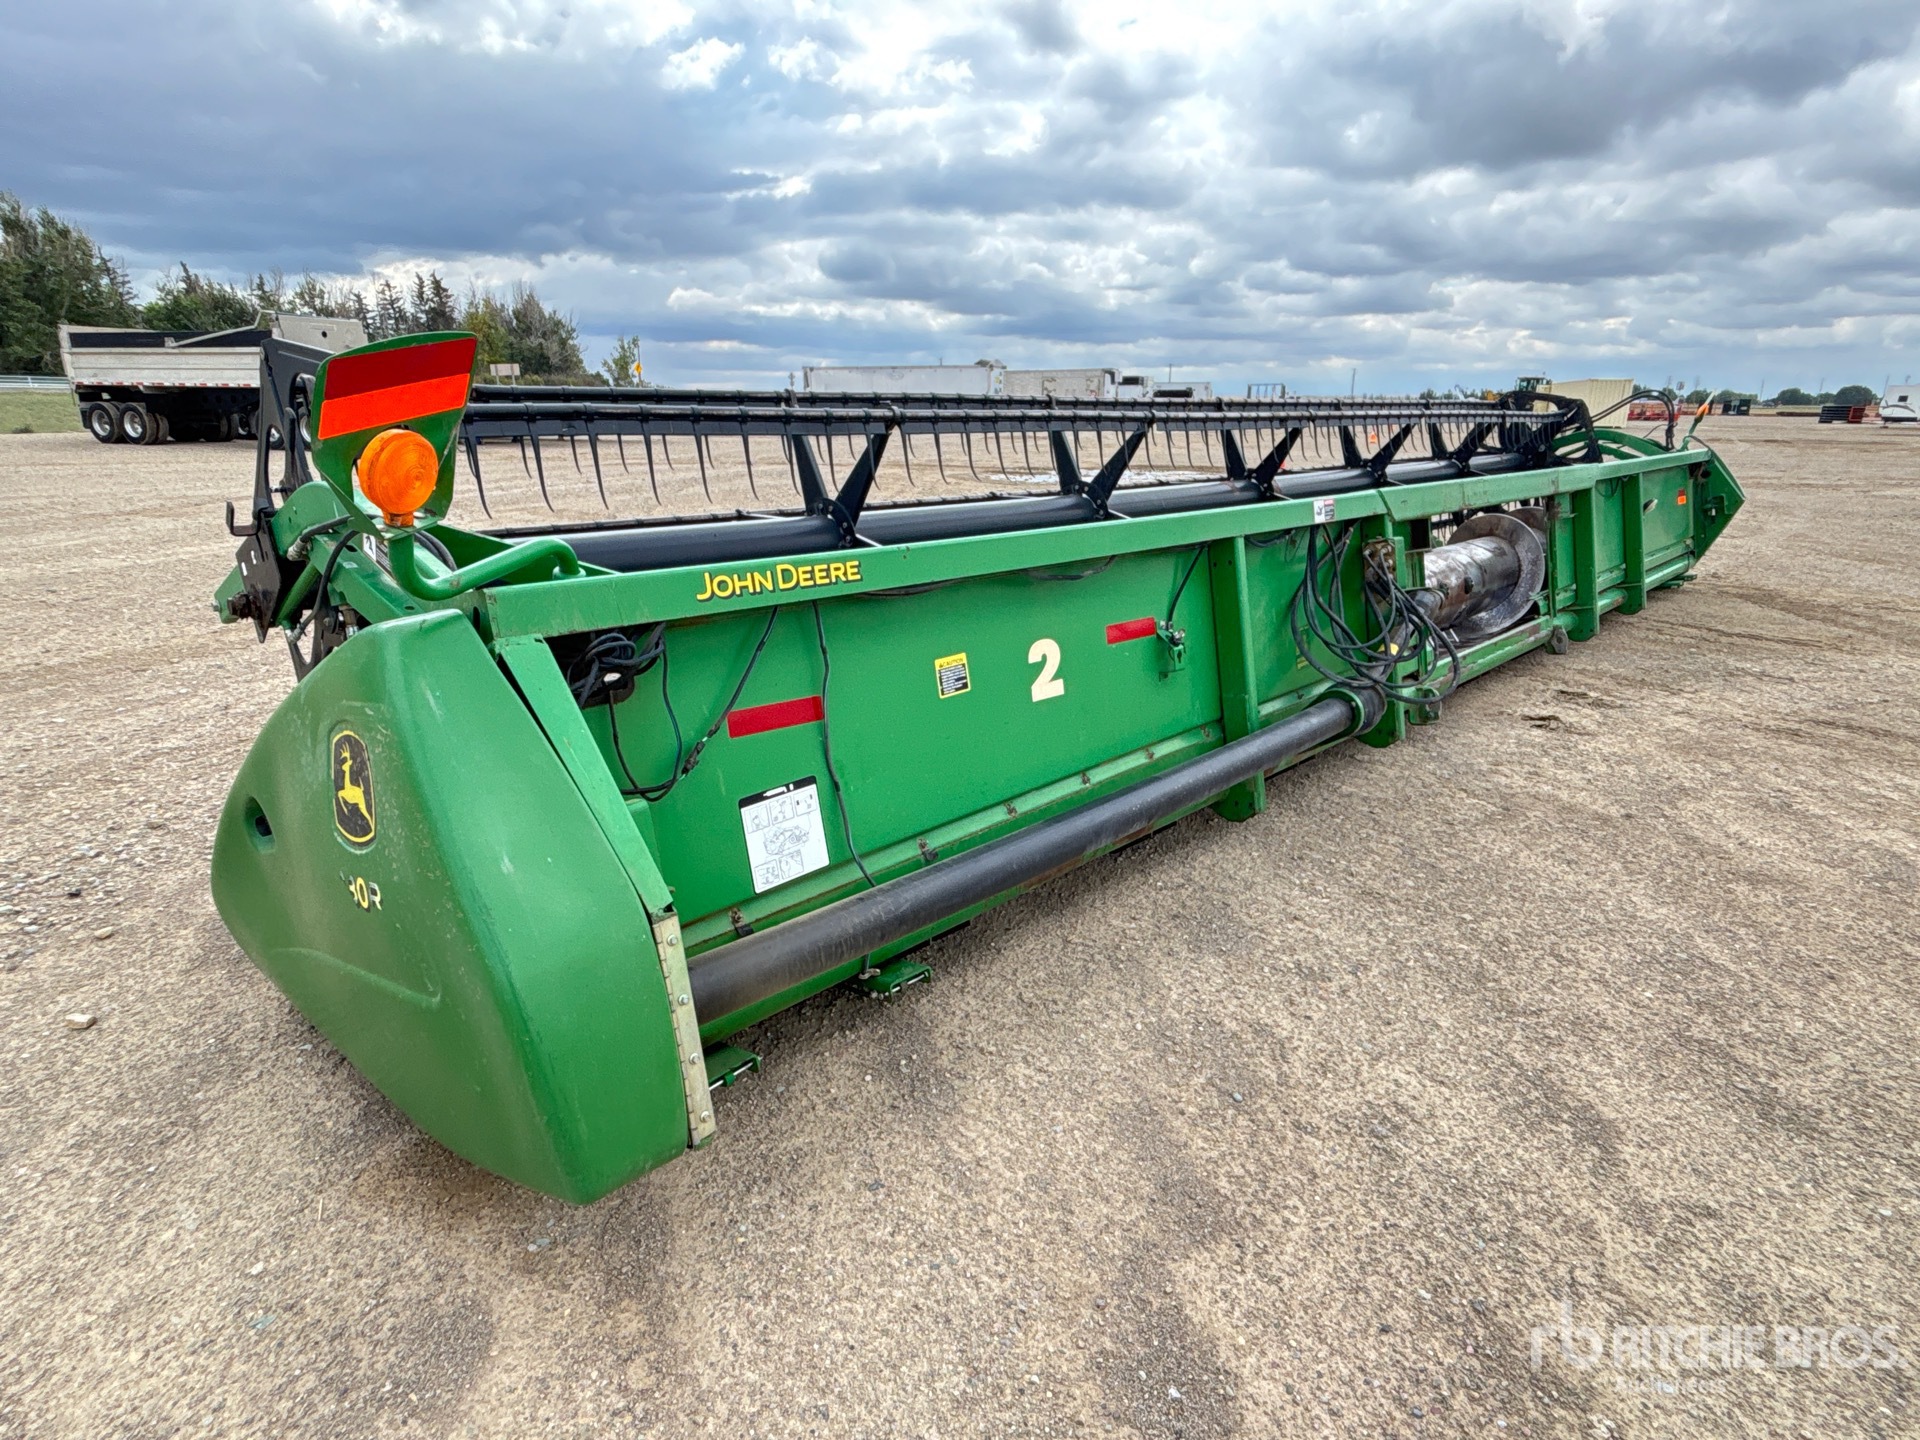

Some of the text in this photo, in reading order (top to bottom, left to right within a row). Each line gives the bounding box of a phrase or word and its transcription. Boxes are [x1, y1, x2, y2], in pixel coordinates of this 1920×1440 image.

[696, 560, 862, 601] JOHN DEERE
[1028, 638, 1065, 703] 2
